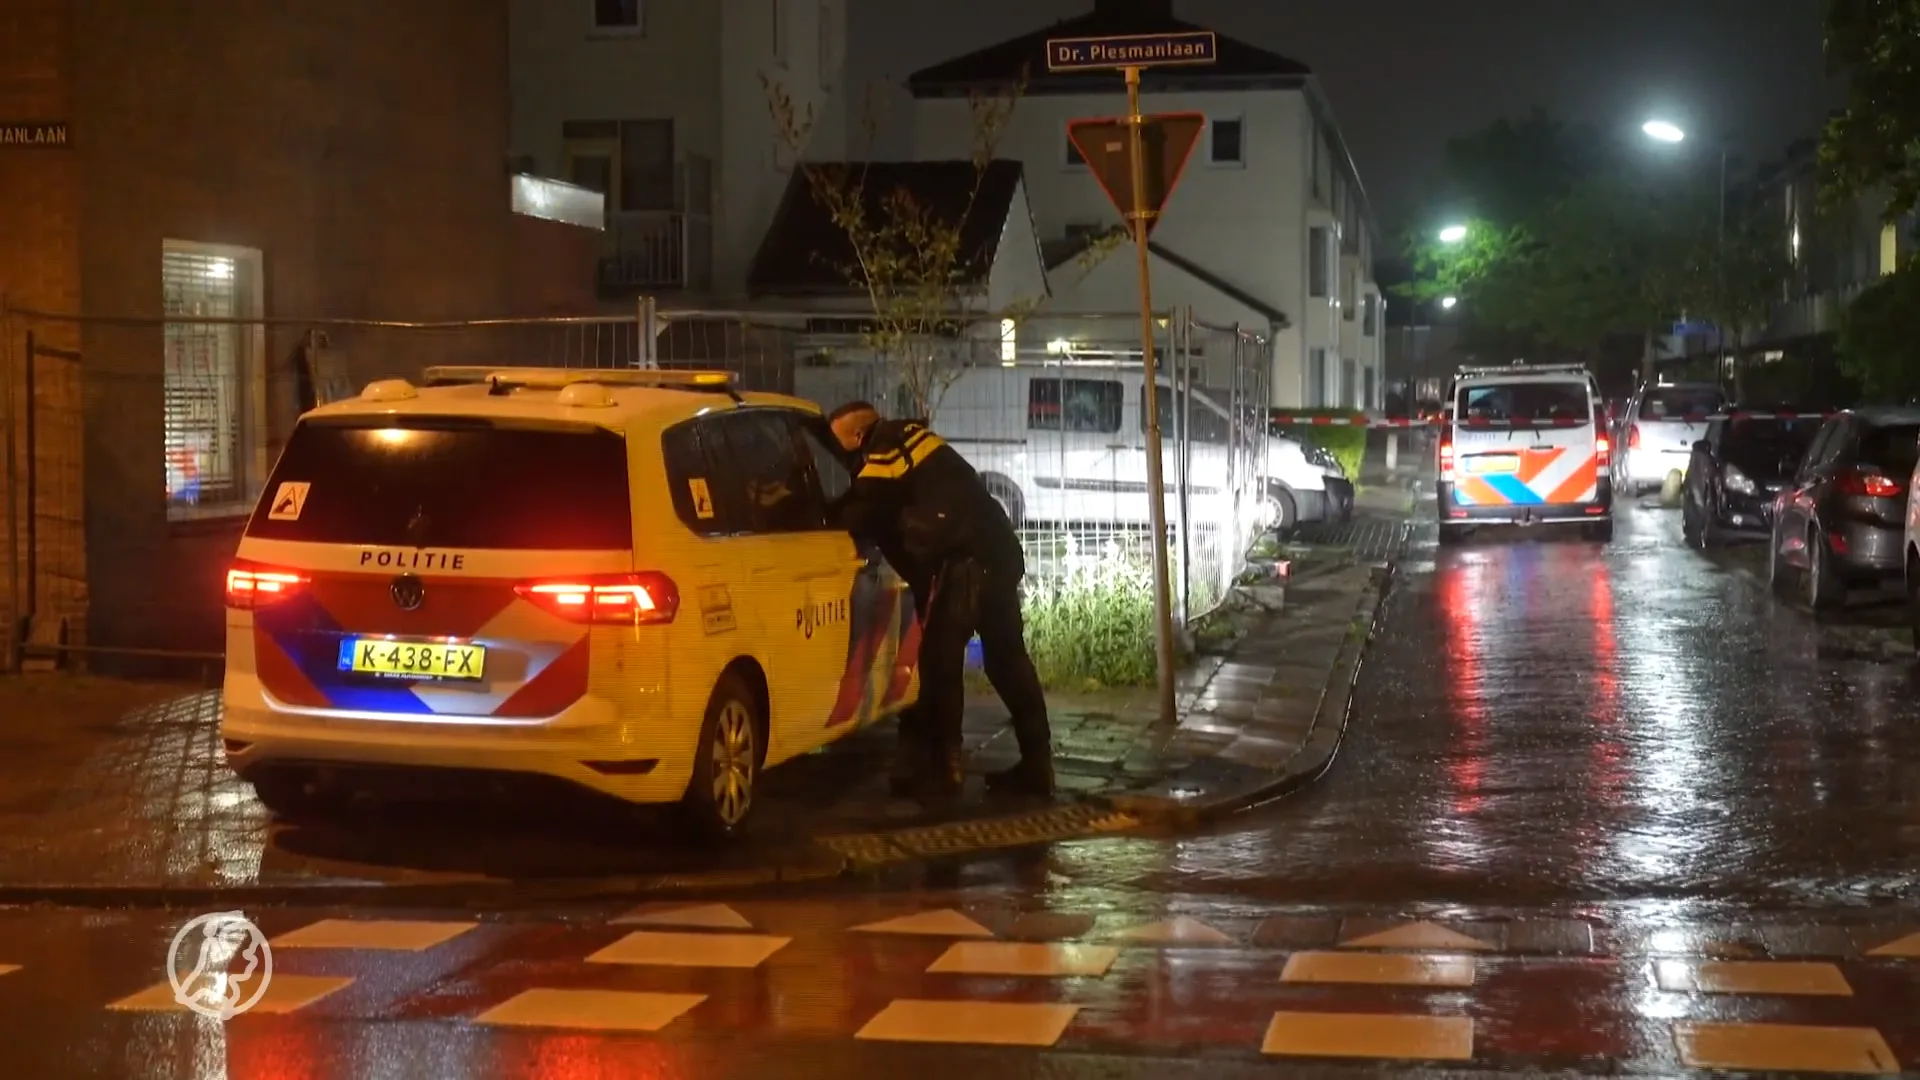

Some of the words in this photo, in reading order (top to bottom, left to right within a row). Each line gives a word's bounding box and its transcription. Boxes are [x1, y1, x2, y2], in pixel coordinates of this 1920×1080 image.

[1058, 46, 1084, 62] Dr.
[1090, 42, 1205, 60] Plesmanlaan
[0, 126, 66, 144] ANLAAN
[360, 551, 465, 570] POLITIE
[362, 644, 473, 674] K-438-FX
